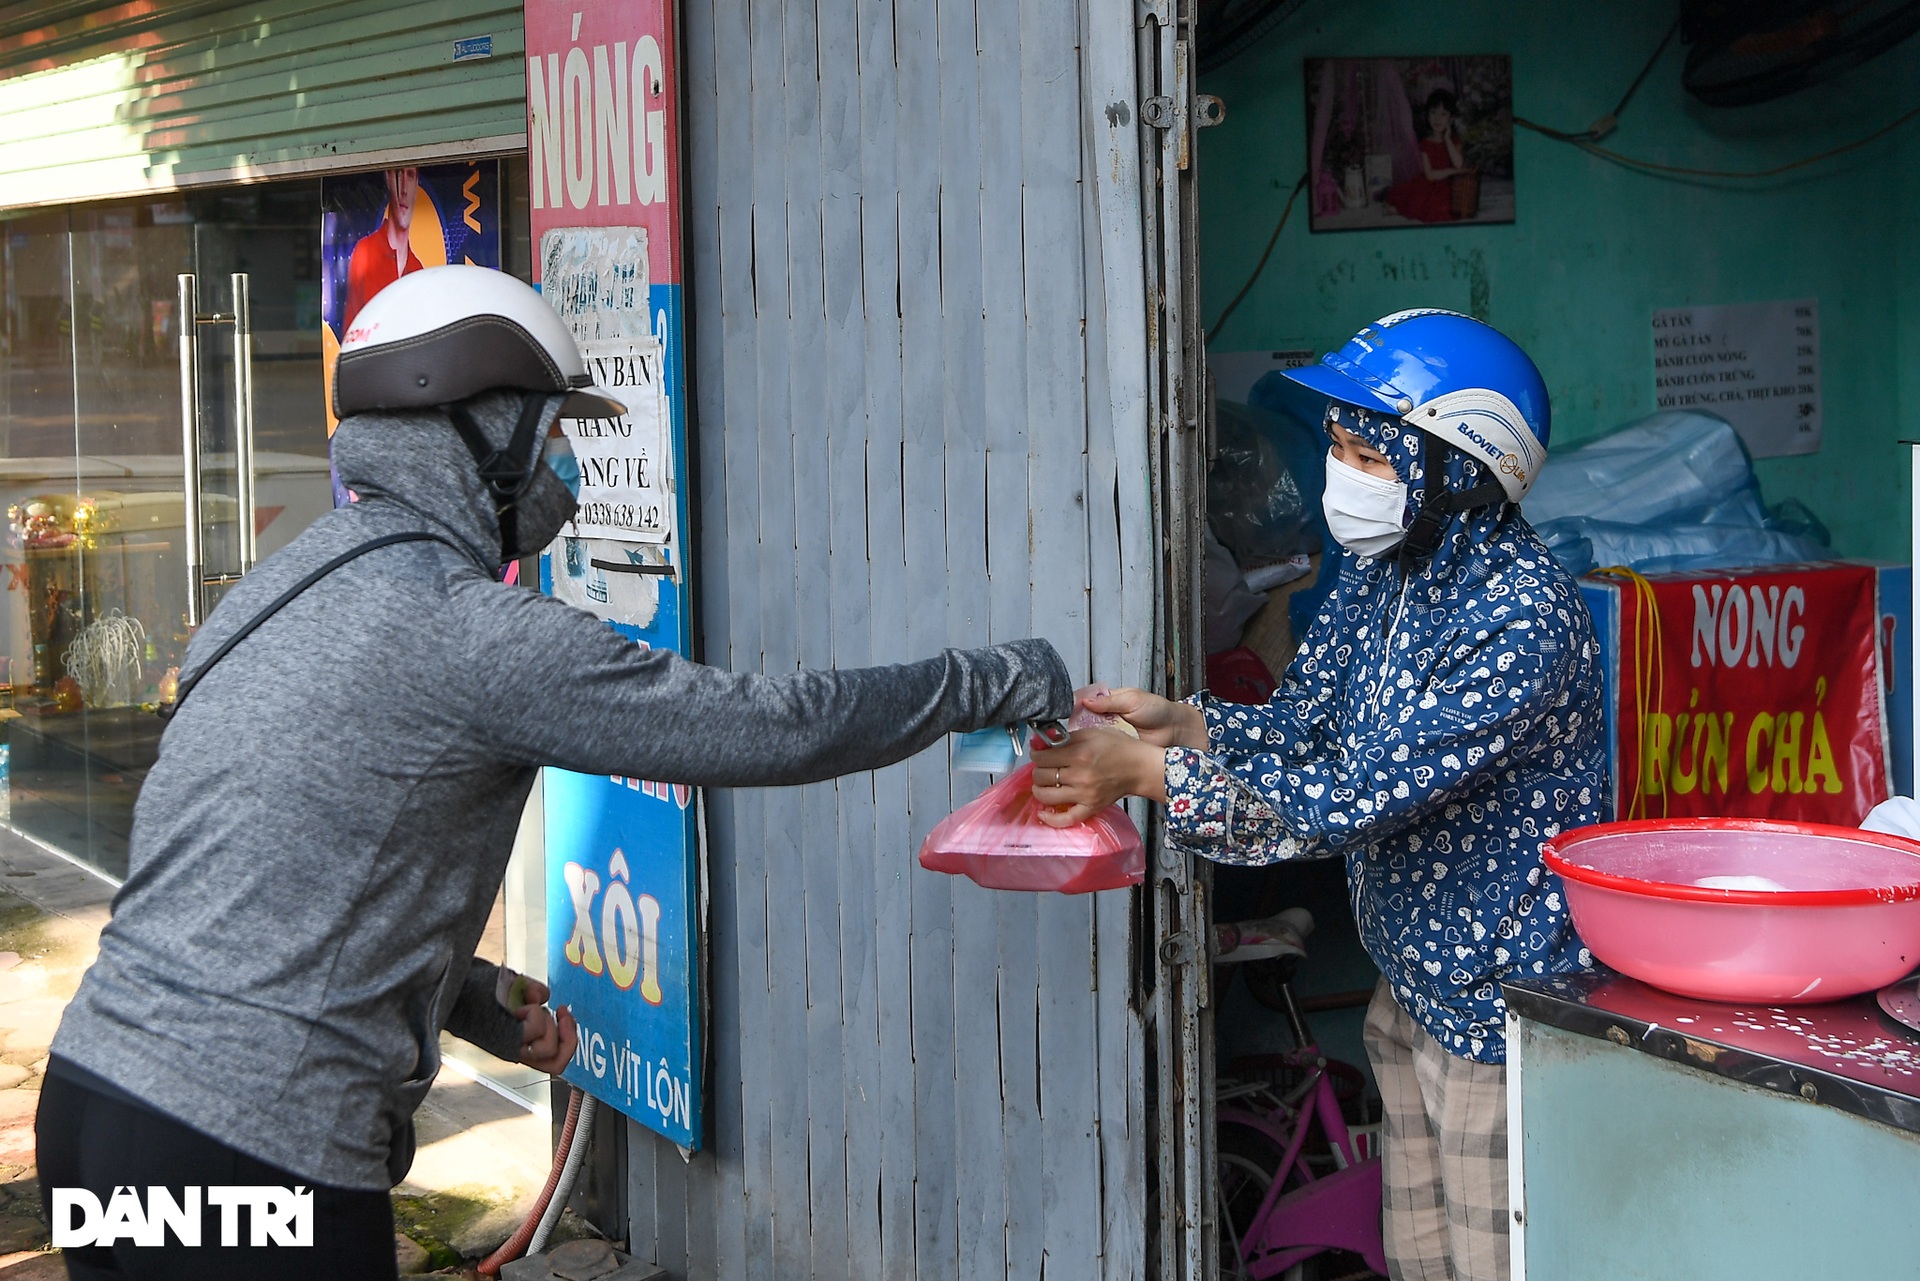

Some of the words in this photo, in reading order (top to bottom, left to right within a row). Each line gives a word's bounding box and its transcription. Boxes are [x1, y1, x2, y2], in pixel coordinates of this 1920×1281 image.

[530, 12, 666, 210] NÓNG
[612, 345, 652, 387] BÁN
[574, 457, 620, 488] ANG
[625, 447, 651, 488] VỀ
[584, 502, 612, 526] 0338
[613, 504, 634, 527] 638
[638, 505, 659, 528] 142
[1642, 688, 1734, 795] BÚN
[1746, 676, 1844, 794] CHẢ
[563, 847, 663, 1007] XÔI
[611, 1039, 641, 1107] VỊT
[647, 1057, 690, 1131] LỘN
